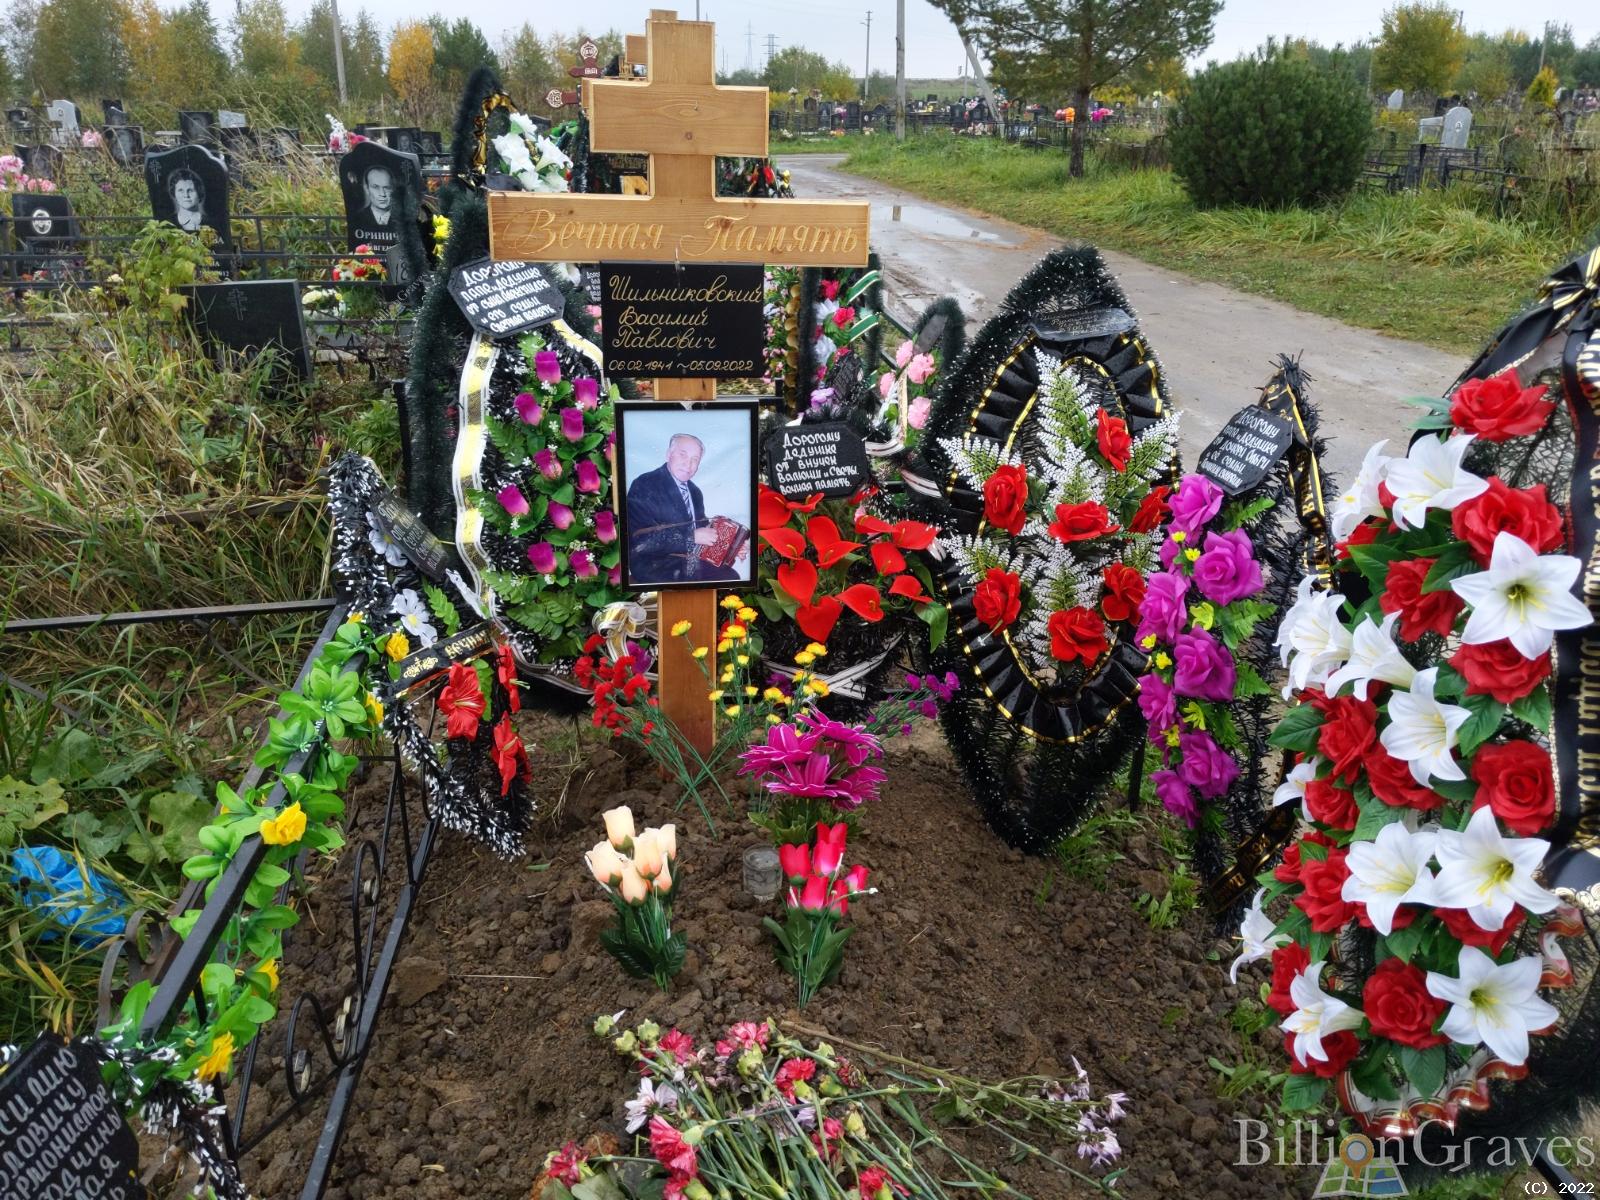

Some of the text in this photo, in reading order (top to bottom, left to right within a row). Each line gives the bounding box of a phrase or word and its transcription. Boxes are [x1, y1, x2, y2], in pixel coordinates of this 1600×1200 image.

[502, 209, 858, 257] Вечная Память
[609, 275, 763, 303] Шильниковский
[619, 306, 709, 326] Василий
[612, 325, 717, 348] Павлович
